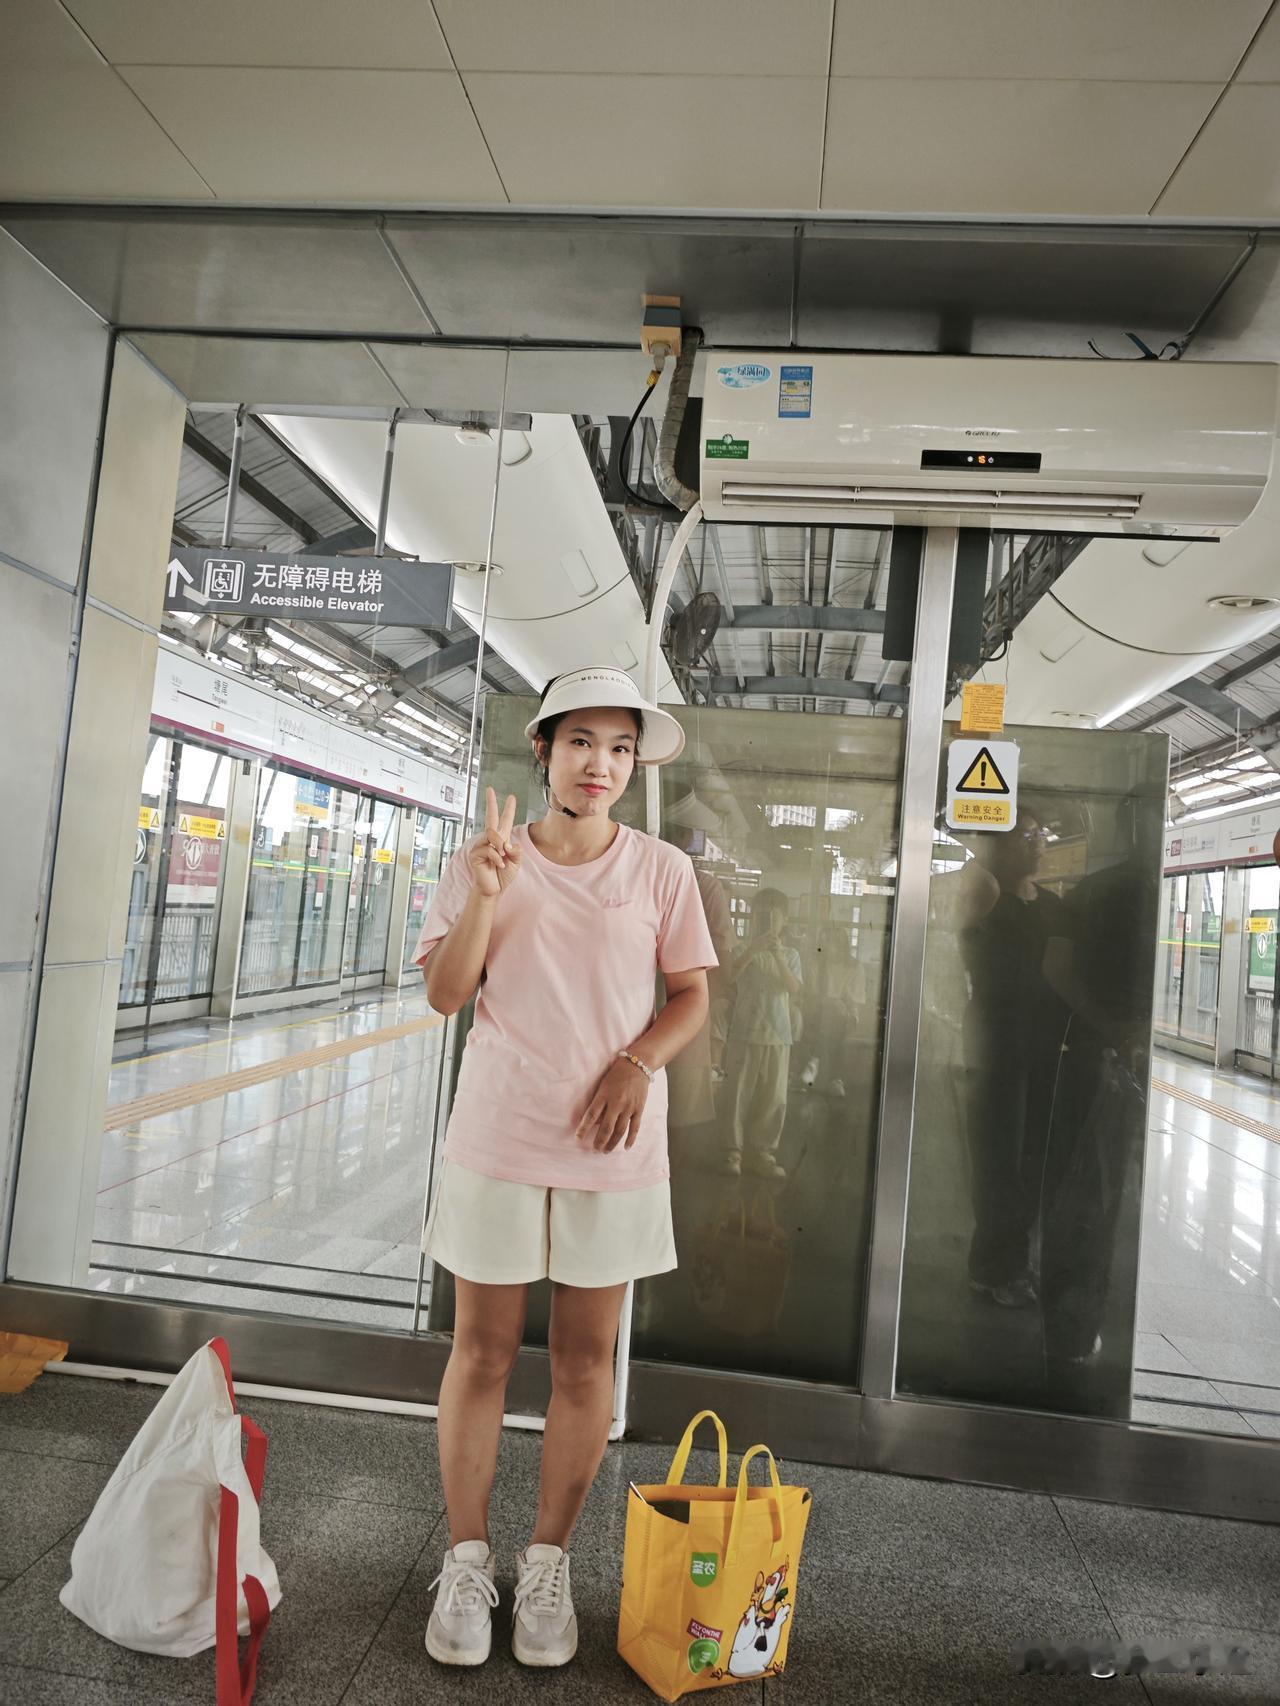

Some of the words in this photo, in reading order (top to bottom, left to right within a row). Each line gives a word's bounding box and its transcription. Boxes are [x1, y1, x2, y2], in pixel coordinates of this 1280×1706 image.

[252, 564, 383, 594] 无障碍电梯
[250, 592, 324, 608] Accessible
[327, 597, 384, 613] Elevator
[957, 813, 983, 821] Warning
[983, 814, 1005, 822] Danger
[961, 804, 1003, 816] 注意安全
